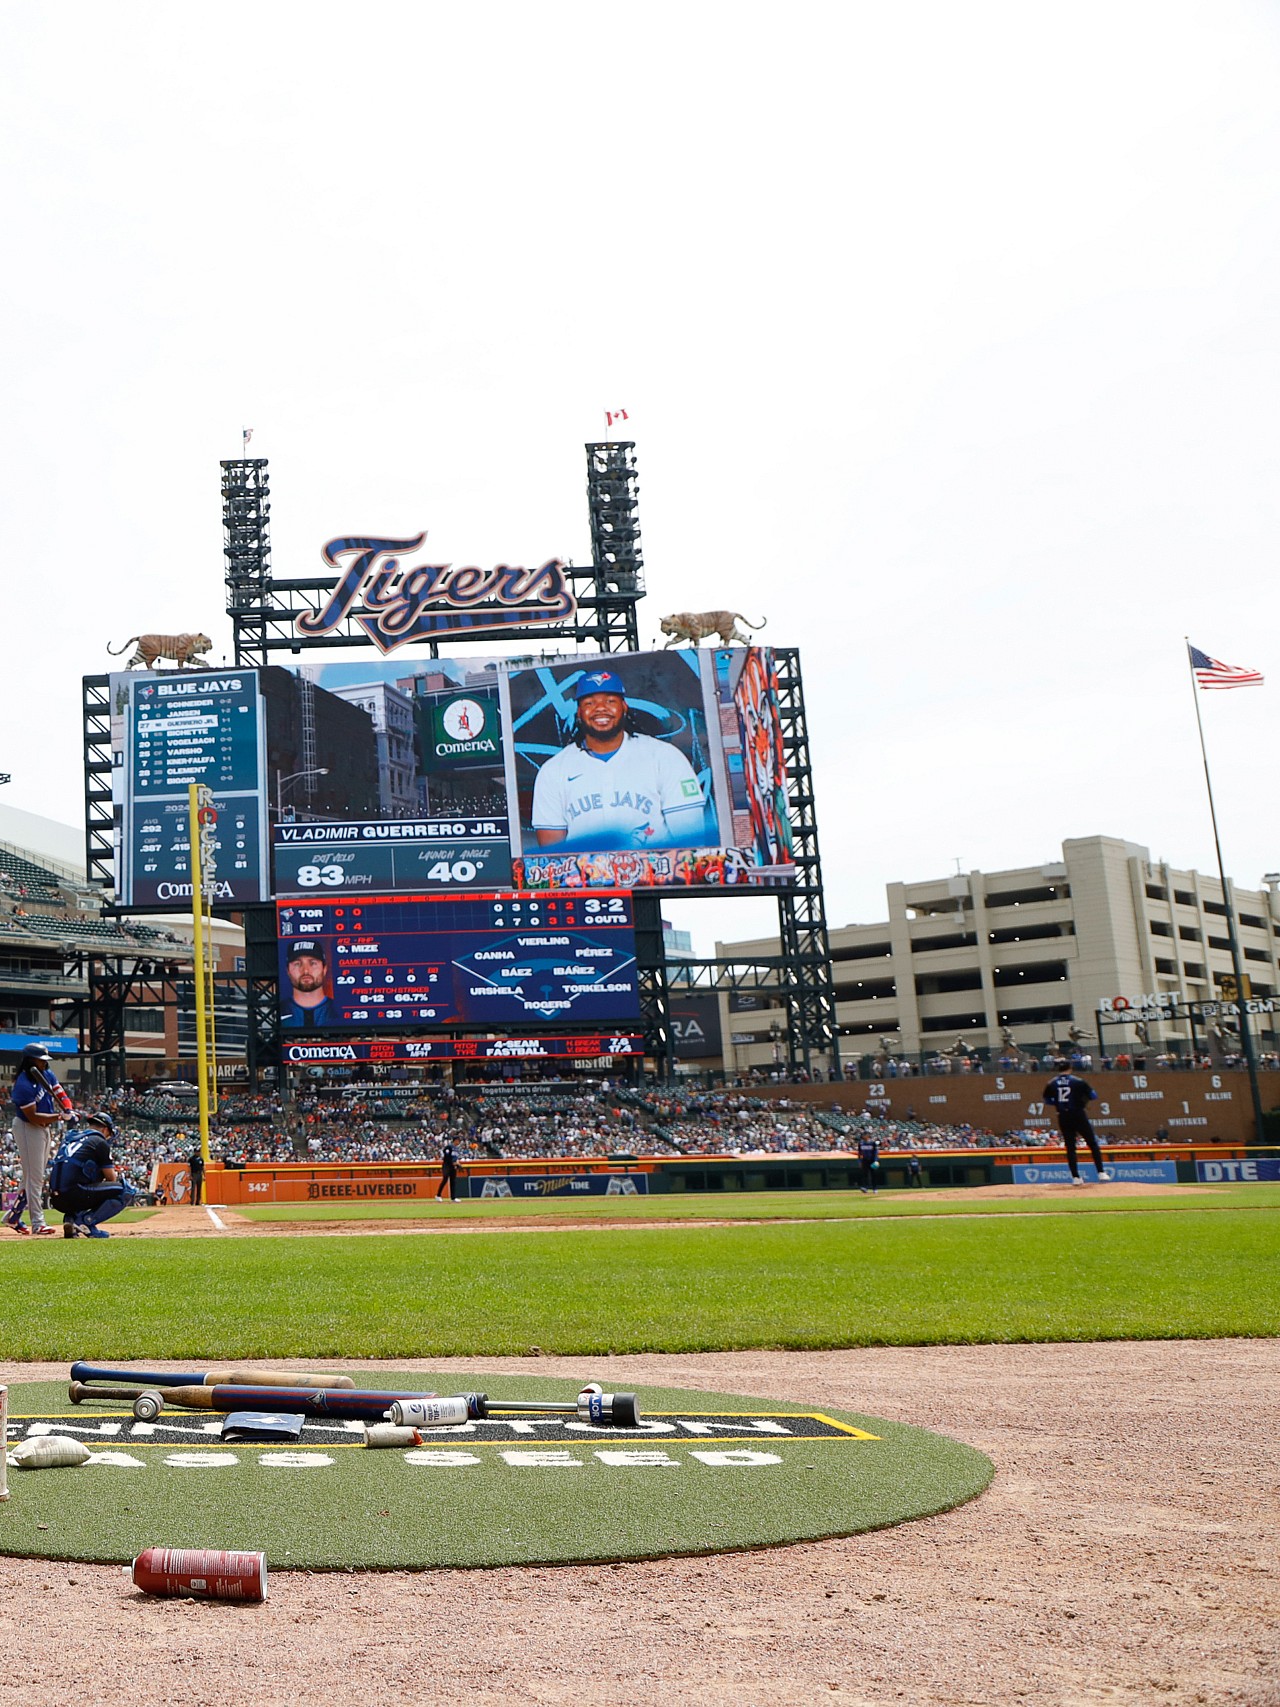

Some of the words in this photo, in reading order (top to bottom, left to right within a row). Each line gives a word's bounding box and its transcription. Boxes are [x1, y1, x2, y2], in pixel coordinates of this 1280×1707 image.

[295, 530, 577, 656] Tigers
[157, 683, 197, 696] BLUE
[198, 679, 242, 691] JAYS
[166, 699, 214, 709] SCHNEIDER
[166, 709, 200, 718] JANSEN
[166, 728, 208, 737] BICHETTE
[166, 737, 216, 746] VOGELBACH
[166, 748, 203, 756] VARSHO
[166, 766, 207, 775] CLEMENT
[166, 777, 196, 785] BIGGIO
[610, 790, 653, 815] JAYS
[281, 827, 358, 841] VLADIMIR
[362, 823, 465, 838] GUERRERO
[470, 822, 502, 835] JR.
[170, 843, 191, 851] .415
[236, 841, 244, 849] 0
[197, 787, 218, 906] ROCKET
[311, 853, 333, 864] EXIT
[332, 852, 355, 863] VELO
[418, 850, 455, 860] LAUNCH
[460, 849, 491, 859] ANGLE
[297, 864, 345, 887] 83
[344, 874, 373, 885] MPH
[529, 856, 579, 886] Detroit
[298, 909, 323, 918] TOR
[335, 908, 344, 917] 0
[352, 907, 362, 916] 0
[493, 903, 503, 912] 0
[512, 903, 521, 912] 3
[529, 902, 539, 911] 0
[547, 902, 557, 910] 4
[585, 898, 624, 913] 3-2
[299, 924, 323, 932] DET
[335, 923, 345, 931] 0
[353, 922, 363, 931] 4
[495, 918, 504, 927] 4
[512, 918, 521, 926] 7
[530, 917, 540, 926] 0
[549, 916, 558, 925] 3
[566, 915, 575, 924] 3
[594, 915, 628, 924] OUTS
[518, 937, 570, 946] VIERLING
[351, 944, 379, 953] MIZE
[474, 951, 515, 960] CANHA
[575, 948, 613, 957] PÉREZ
[501, 966, 532, 977] BÁEZ
[553, 965, 595, 975] IBÁÑEZ
[337, 976, 355, 985] 2.0
[364, 975, 373, 984] 3
[385, 974, 395, 983] 0
[407, 974, 416, 983] 0
[428, 973, 438, 982] 2
[470, 986, 524, 996] URSHELA
[562, 983, 631, 993] TORKELSON
[360, 994, 385, 1003] 8-12
[394, 993, 428, 1002] 66.7%
[1100, 991, 1181, 1011] ROCKET
[524, 1000, 571, 1010] ROGERS
[352, 1011, 369, 1019] 23
[386, 1010, 403, 1019] 33
[419, 1009, 436, 1017] 56
[405, 1043, 432, 1051] 97.5
[494, 1040, 540, 1048] 4-SEAM
[486, 1047, 548, 1056] FASTBALL
[609, 1045, 632, 1053] 17.4
[574, 1056, 613, 1069] BISTRO
[373, 1065, 390, 1074] EXIT
[995, 1077, 1006, 1090] 5
[1132, 1075, 1147, 1089] 16
[1211, 1075, 1222, 1088] 6
[481, 1086, 513, 1095] Together
[514, 1086, 531, 1094] let's
[532, 1085, 550, 1093] drive
[869, 1083, 885, 1097] 23
[1057, 1086, 1071, 1102] 12
[1120, 1090, 1164, 1100] NEWHOUSER
[1205, 1091, 1232, 1100] KALINE
[1027, 1102, 1044, 1116] 47
[1100, 1102, 1110, 1115] 3
[1182, 1101, 1190, 1114] 1
[1168, 1117, 1208, 1127] WHITAKER
[1117, 1168, 1167, 1178] FANDUEL
[1204, 1161, 1258, 1181] DTE
[524, 1182, 538, 1191] IT'S
[536, 1176, 576, 1195] Miller
[570, 1181, 590, 1190] TIME
[403, 1449, 784, 1468] SEED
